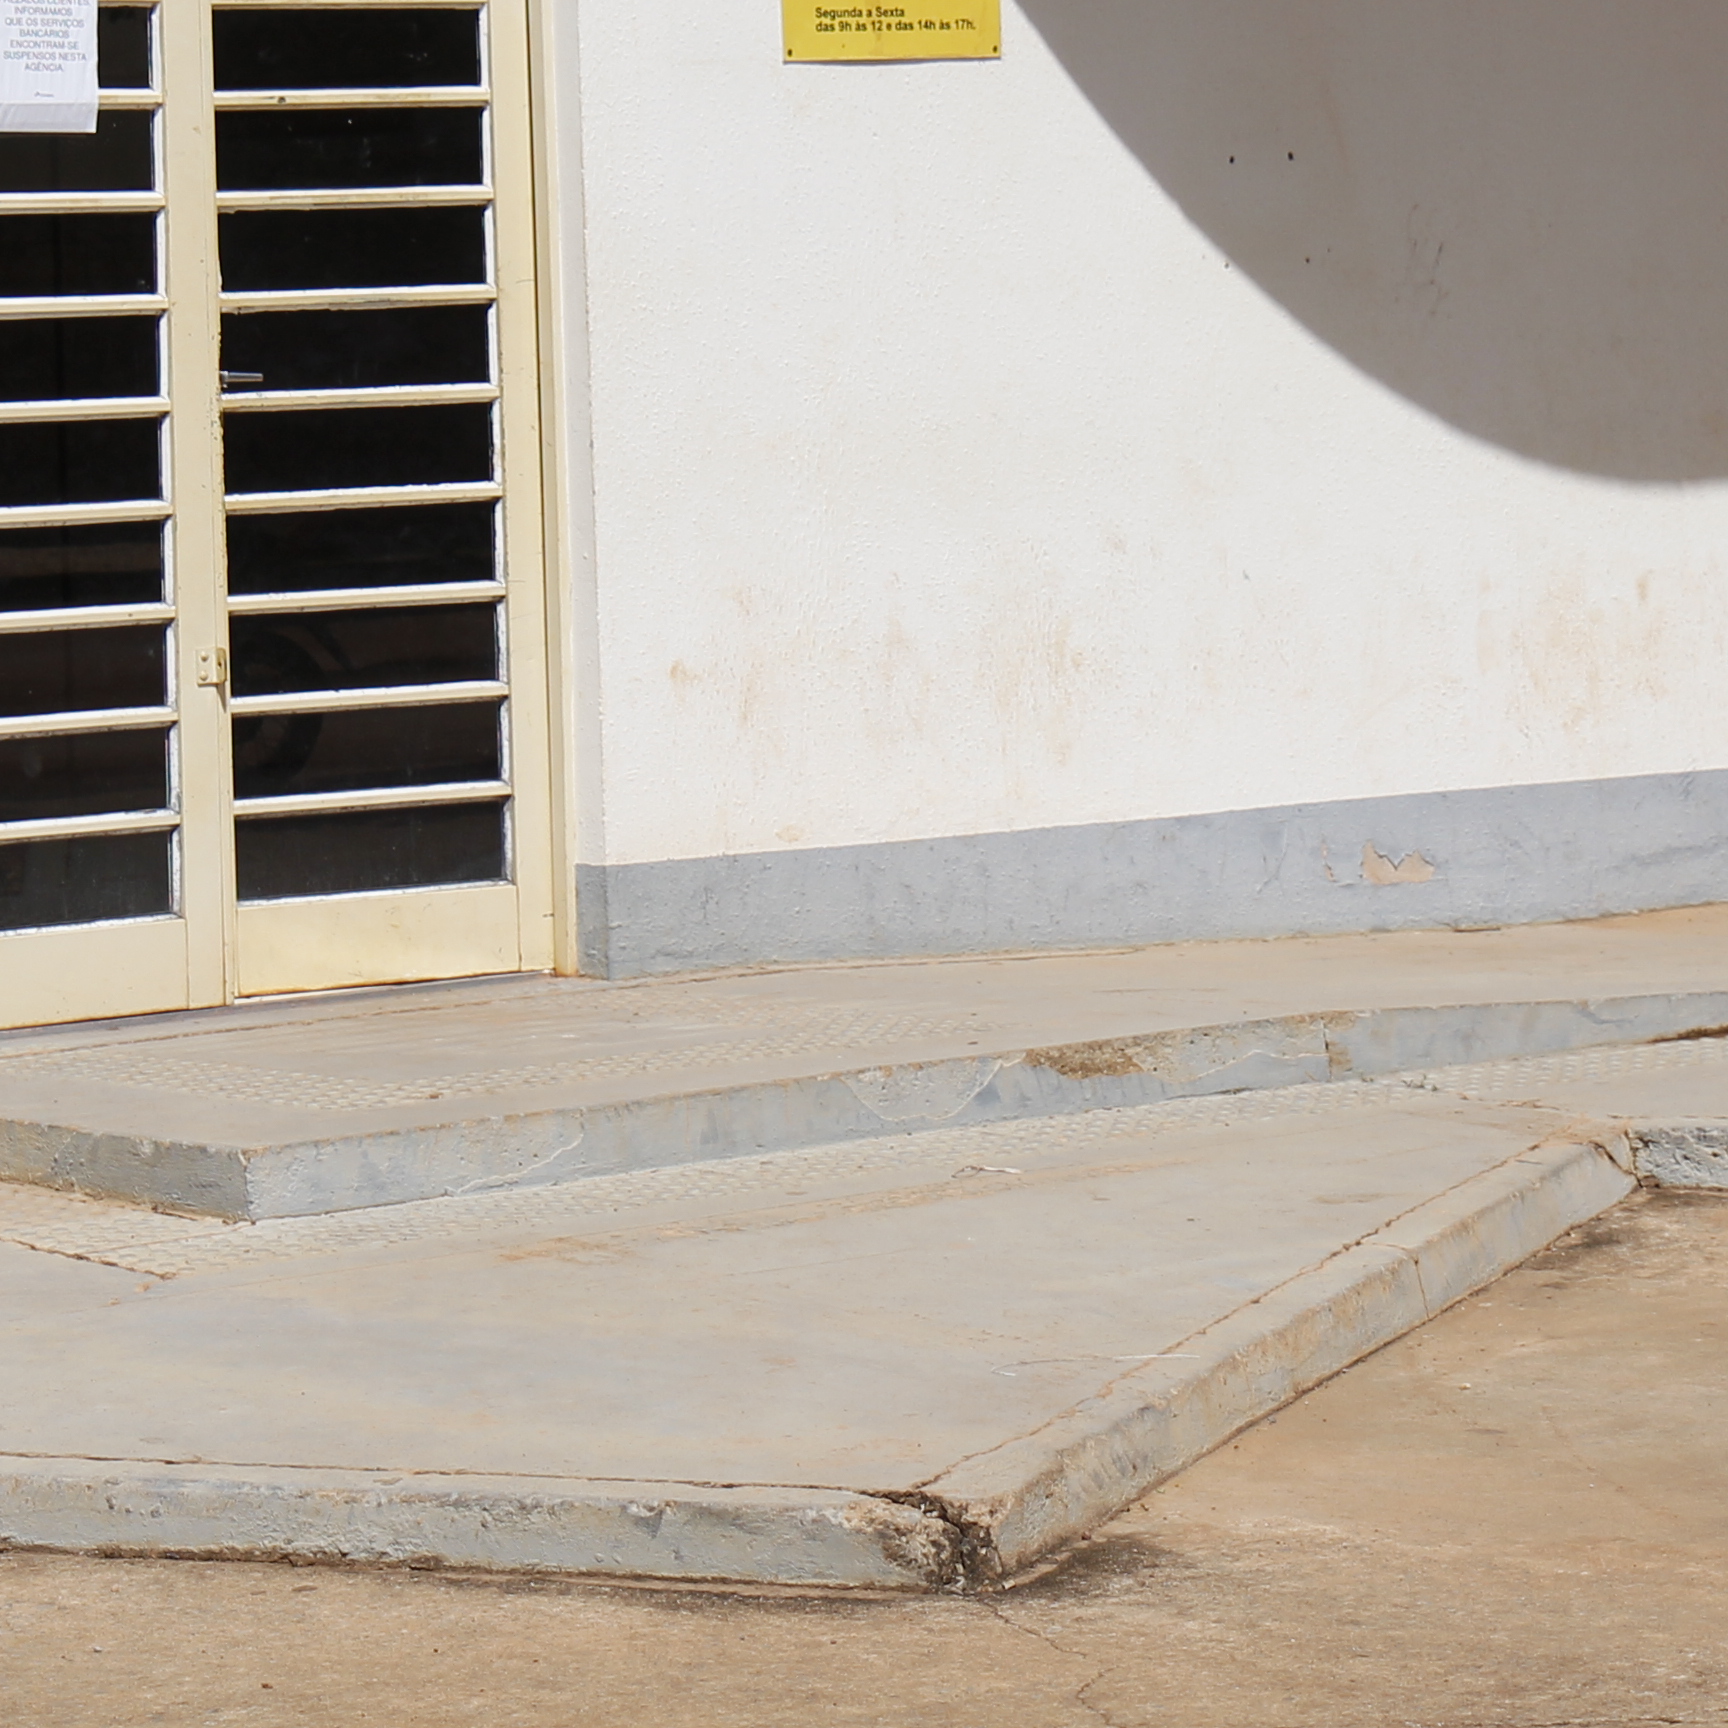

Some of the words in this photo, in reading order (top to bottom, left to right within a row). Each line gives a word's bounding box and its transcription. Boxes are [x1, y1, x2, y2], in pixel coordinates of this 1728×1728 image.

[14, 6, 73, 16] INFORMAMOS
[815, 6, 863, 20] Segunda
[865, 9, 873, 18] a
[875, 6, 905, 18] Sexta
[4, 17, 23, 26] QUE
[25, 17, 38, 27] OS
[40, 18, 85, 29] SERVIÇOS
[815, 20, 835, 32] das
[838, 20, 852, 32] 9h
[855, 20, 867, 32] às
[871, 20, 883, 31] 12
[885, 22, 892, 31] e
[895, 19, 914, 31] das
[917, 19, 935, 30] 14h
[939, 19, 951, 30] às
[19, 27, 70, 39] BANCÁRIOS
[3, 50, 57, 61] SUSPENSOS
[58, 52, 87, 61] NESTA
